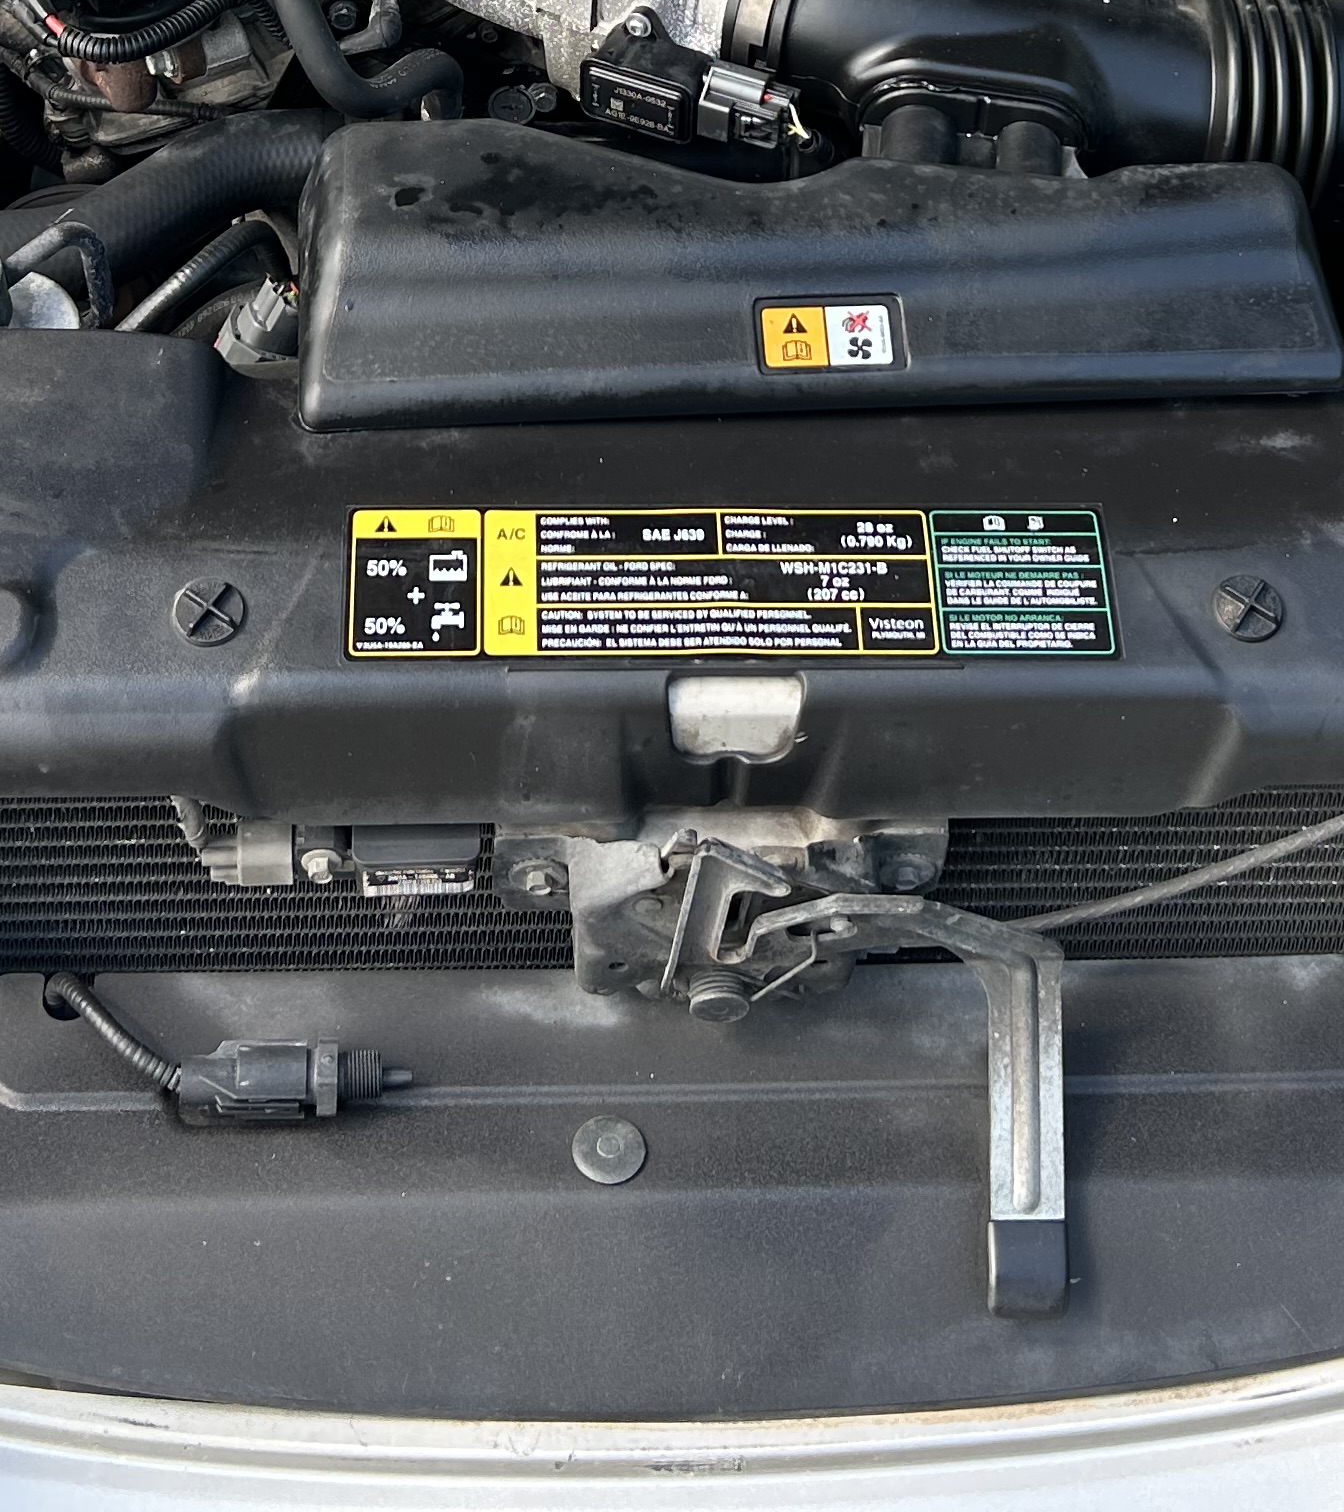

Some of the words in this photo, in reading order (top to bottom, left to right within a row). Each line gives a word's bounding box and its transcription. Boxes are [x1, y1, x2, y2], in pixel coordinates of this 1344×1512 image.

[540, 517, 584, 525] COMPLIES
[585, 517, 610, 525] WITH:
[724, 516, 760, 525] CHARGE
[762, 517, 789, 525] LEVEL
[876, 522, 894, 533] oz
[497, 527, 526, 542] A/C
[591, 529, 598, 539] À
[599, 531, 610, 539] LA
[642, 529, 670, 541] SAE
[674, 529, 705, 541] J639
[725, 530, 762, 538] CHARGE
[886, 536, 912, 549] Kg)
[540, 544, 575, 554] NORME:
[726, 544, 757, 552] CARGA
[758, 544, 770, 552] DE
[772, 544, 815, 552] LLENADO:
[941, 546, 970, 554] CHECK
[971, 546, 992, 554] FUEL
[994, 546, 1031, 554] SHUTOFF
[1032, 546, 1063, 554] SWITCH
[1064, 546, 1076, 554] AS
[366, 559, 408, 576] 50%
[541, 562, 601, 570] REFRIGERANT
[603, 562, 618, 570] OIL
[624, 562, 649, 570] FORD
[650, 562, 675, 570] SPEC:
[780, 562, 888, 574] WSH-M1C231-B
[541, 577, 592, 586] LUBRIFIANT
[598, 577, 647, 586] CONFORME
[649, 575, 655, 585] À
[656, 576, 669, 585] LA
[671, 576, 702, 585] NORME
[703, 576, 727, 585] FORD
[820, 576, 828, 587] 7
[832, 576, 850, 587] oz
[542, 592, 559, 601] USE
[561, 592, 591, 601] ACEITE
[592, 592, 616, 600] PARA
[617, 591, 688, 600] REFRIGERANTES
[690, 591, 738, 600] CONFORME
[740, 591, 749, 600] A:
[807, 588, 838, 601] (207
[841, 588, 865, 601] cc)
[542, 611, 583, 620] CAUTION:
[586, 611, 622, 620] SYSTEM
[624, 611, 636, 620] TO
[638, 611, 650, 620] BE
[652, 610, 695, 620] SERVICED
[696, 610, 708, 620] BY
[710, 610, 755, 619] QUALIFIED
[364, 616, 406, 635] 50%
[868, 617, 924, 630] Visteon
[542, 625, 562, 634] MISE
[565, 625, 577, 634] EN
[579, 625, 610, 633] GARDE
[616, 625, 629, 633] NE
[630, 625, 668, 633] CONFIER
[745, 624, 756, 633] UN
[758, 624, 811, 633] PERSONNEL
[606, 639, 617, 648] EL
[619, 639, 657, 648] SISTEMA
[658, 638, 682, 648] DEBE
[684, 638, 702, 647] SER
[703, 638, 746, 647] ATENDIDO
[748, 638, 772, 647] SOLO
[774, 638, 793, 647] POR
